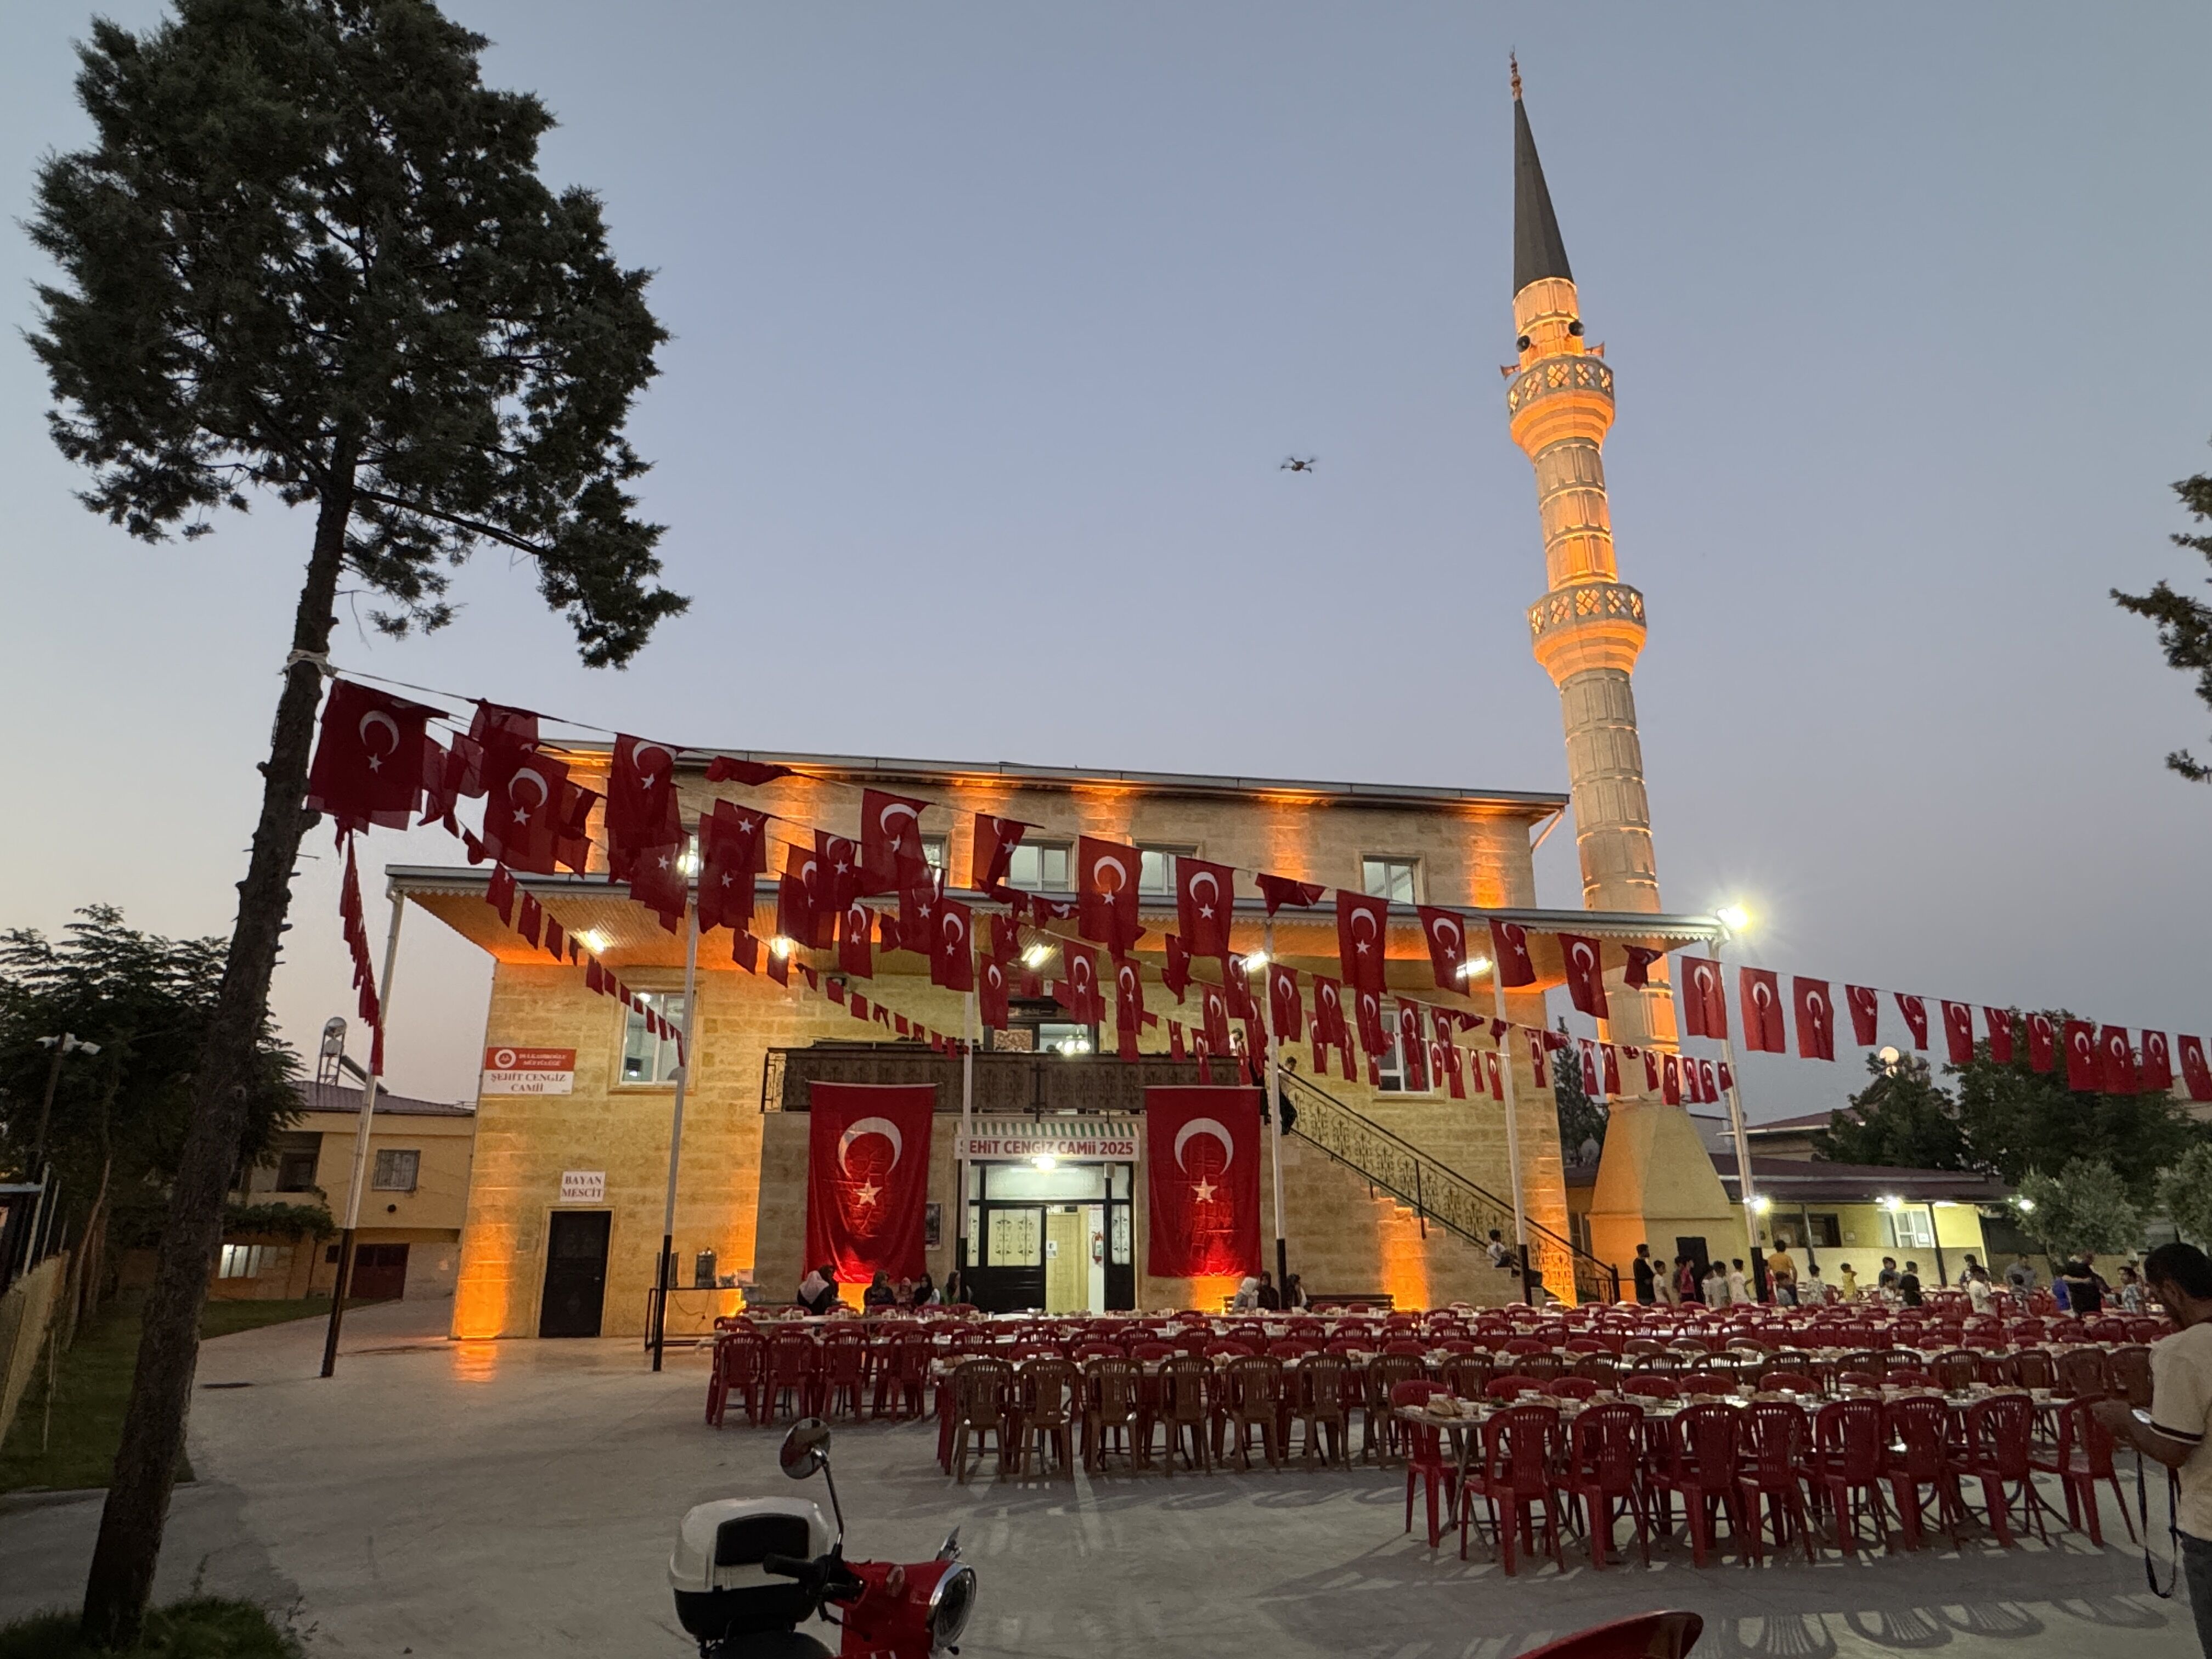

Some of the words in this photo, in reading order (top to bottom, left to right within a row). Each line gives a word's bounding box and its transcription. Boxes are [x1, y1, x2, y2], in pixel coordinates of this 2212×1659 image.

[491, 1071, 524, 1082] ŞEHİT
[526, 1072, 567, 1082] CENGİZ
[511, 1082, 544, 1092] CAMİİ
[1099, 1141, 1133, 1155] 2025
[565, 1176, 601, 1185] BAYAN
[562, 1187, 601, 1197] MESCİT
